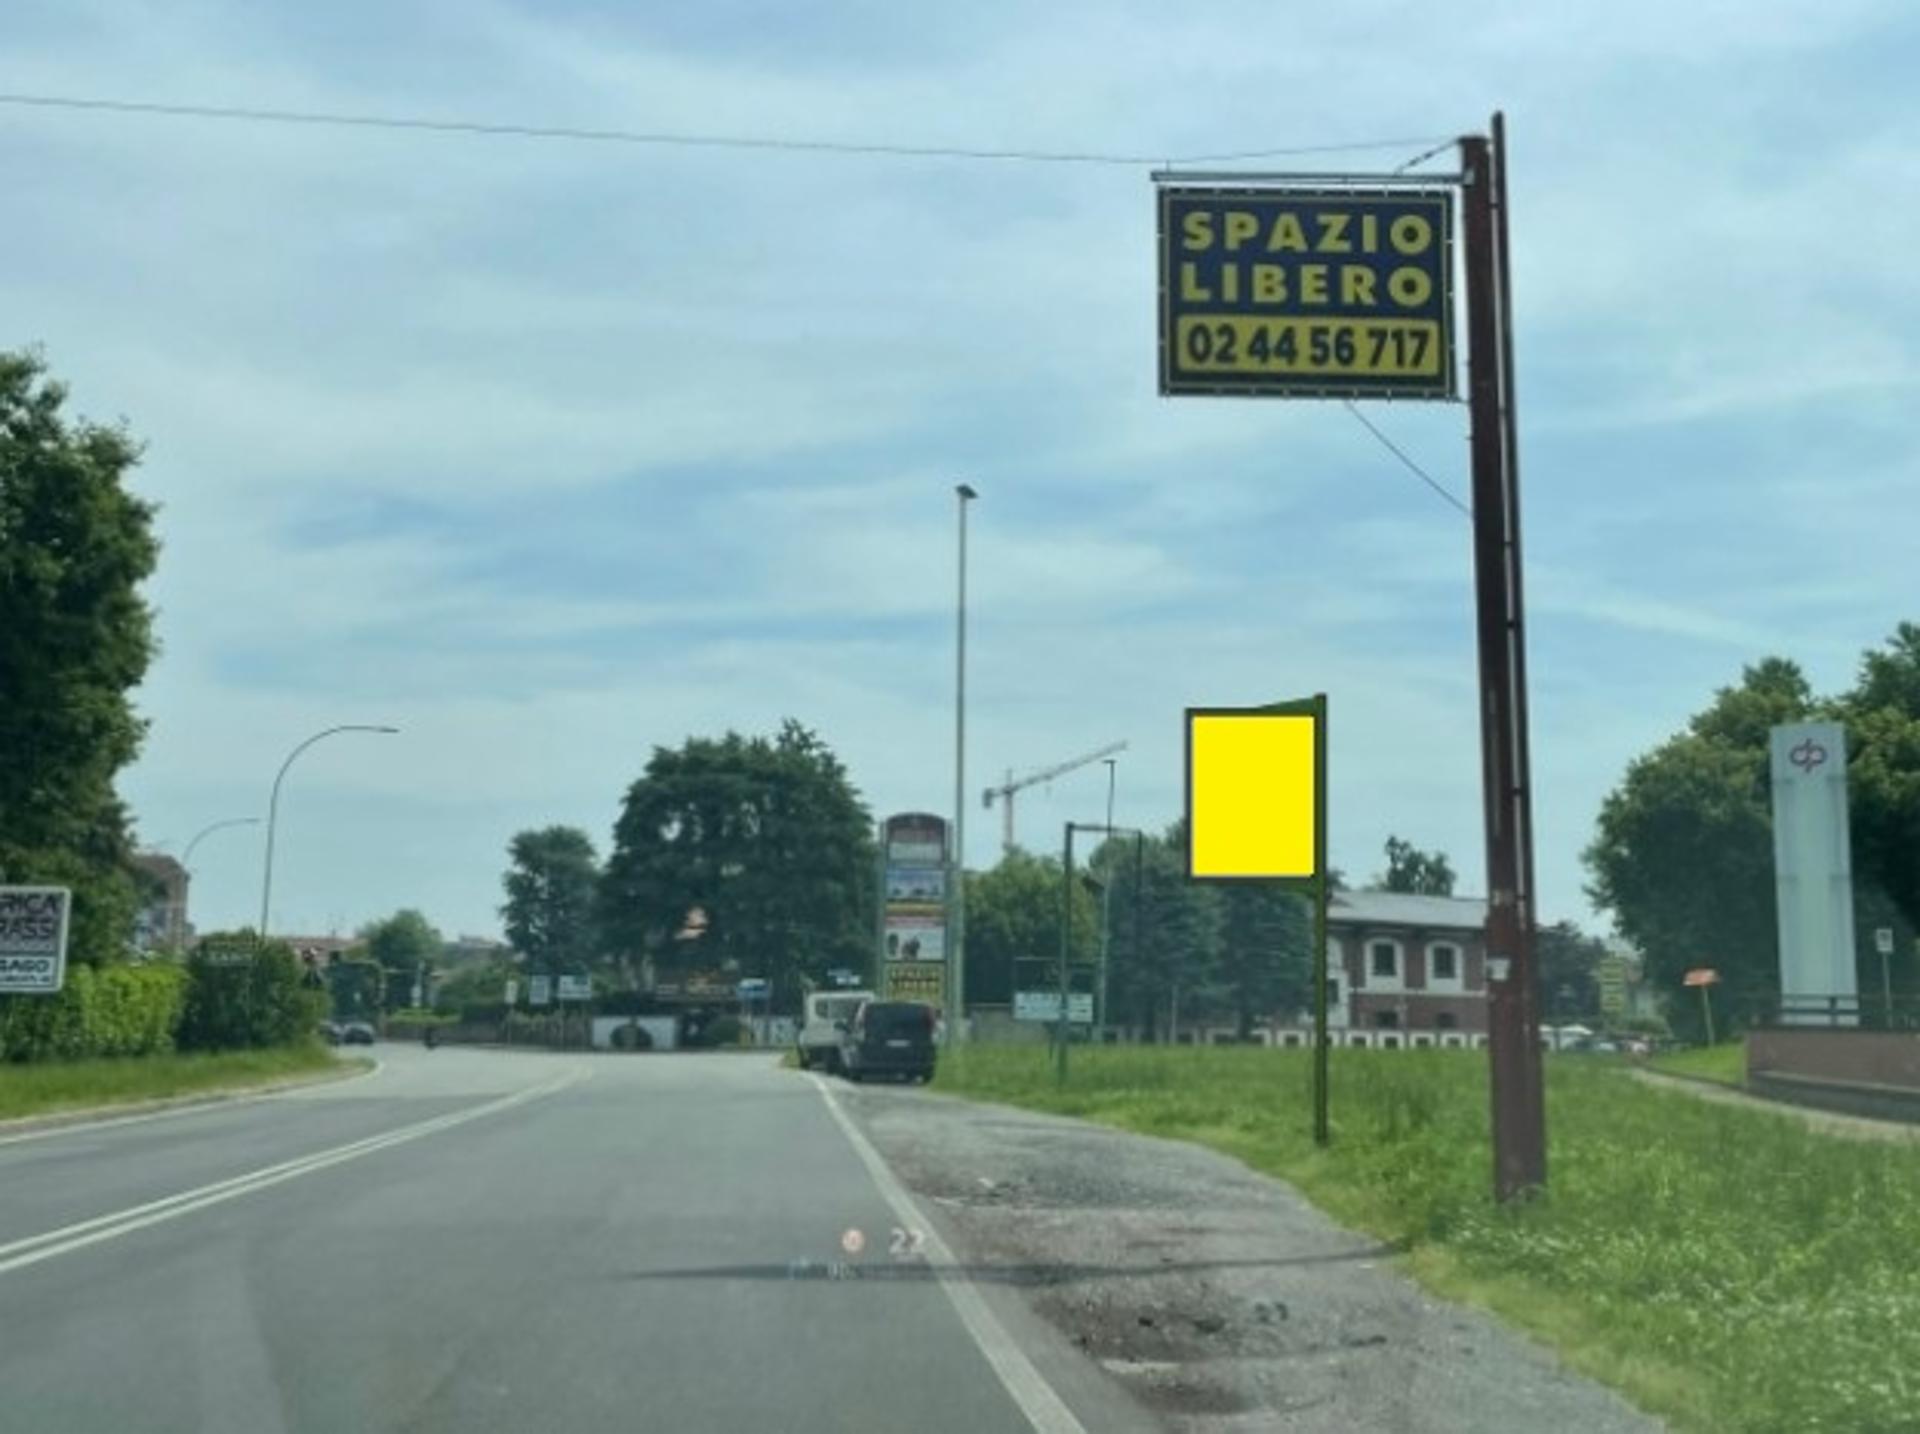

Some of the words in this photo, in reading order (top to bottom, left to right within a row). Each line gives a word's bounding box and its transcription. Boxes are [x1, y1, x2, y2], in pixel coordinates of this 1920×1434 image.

[1182, 211, 1432, 254] SPAZIO
[1181, 262, 1432, 306] LIBERO
[1187, 323, 1236, 365] 02
[1248, 326, 1296, 366] 44
[1310, 326, 1355, 367] 56
[1368, 328, 1429, 368] 717
